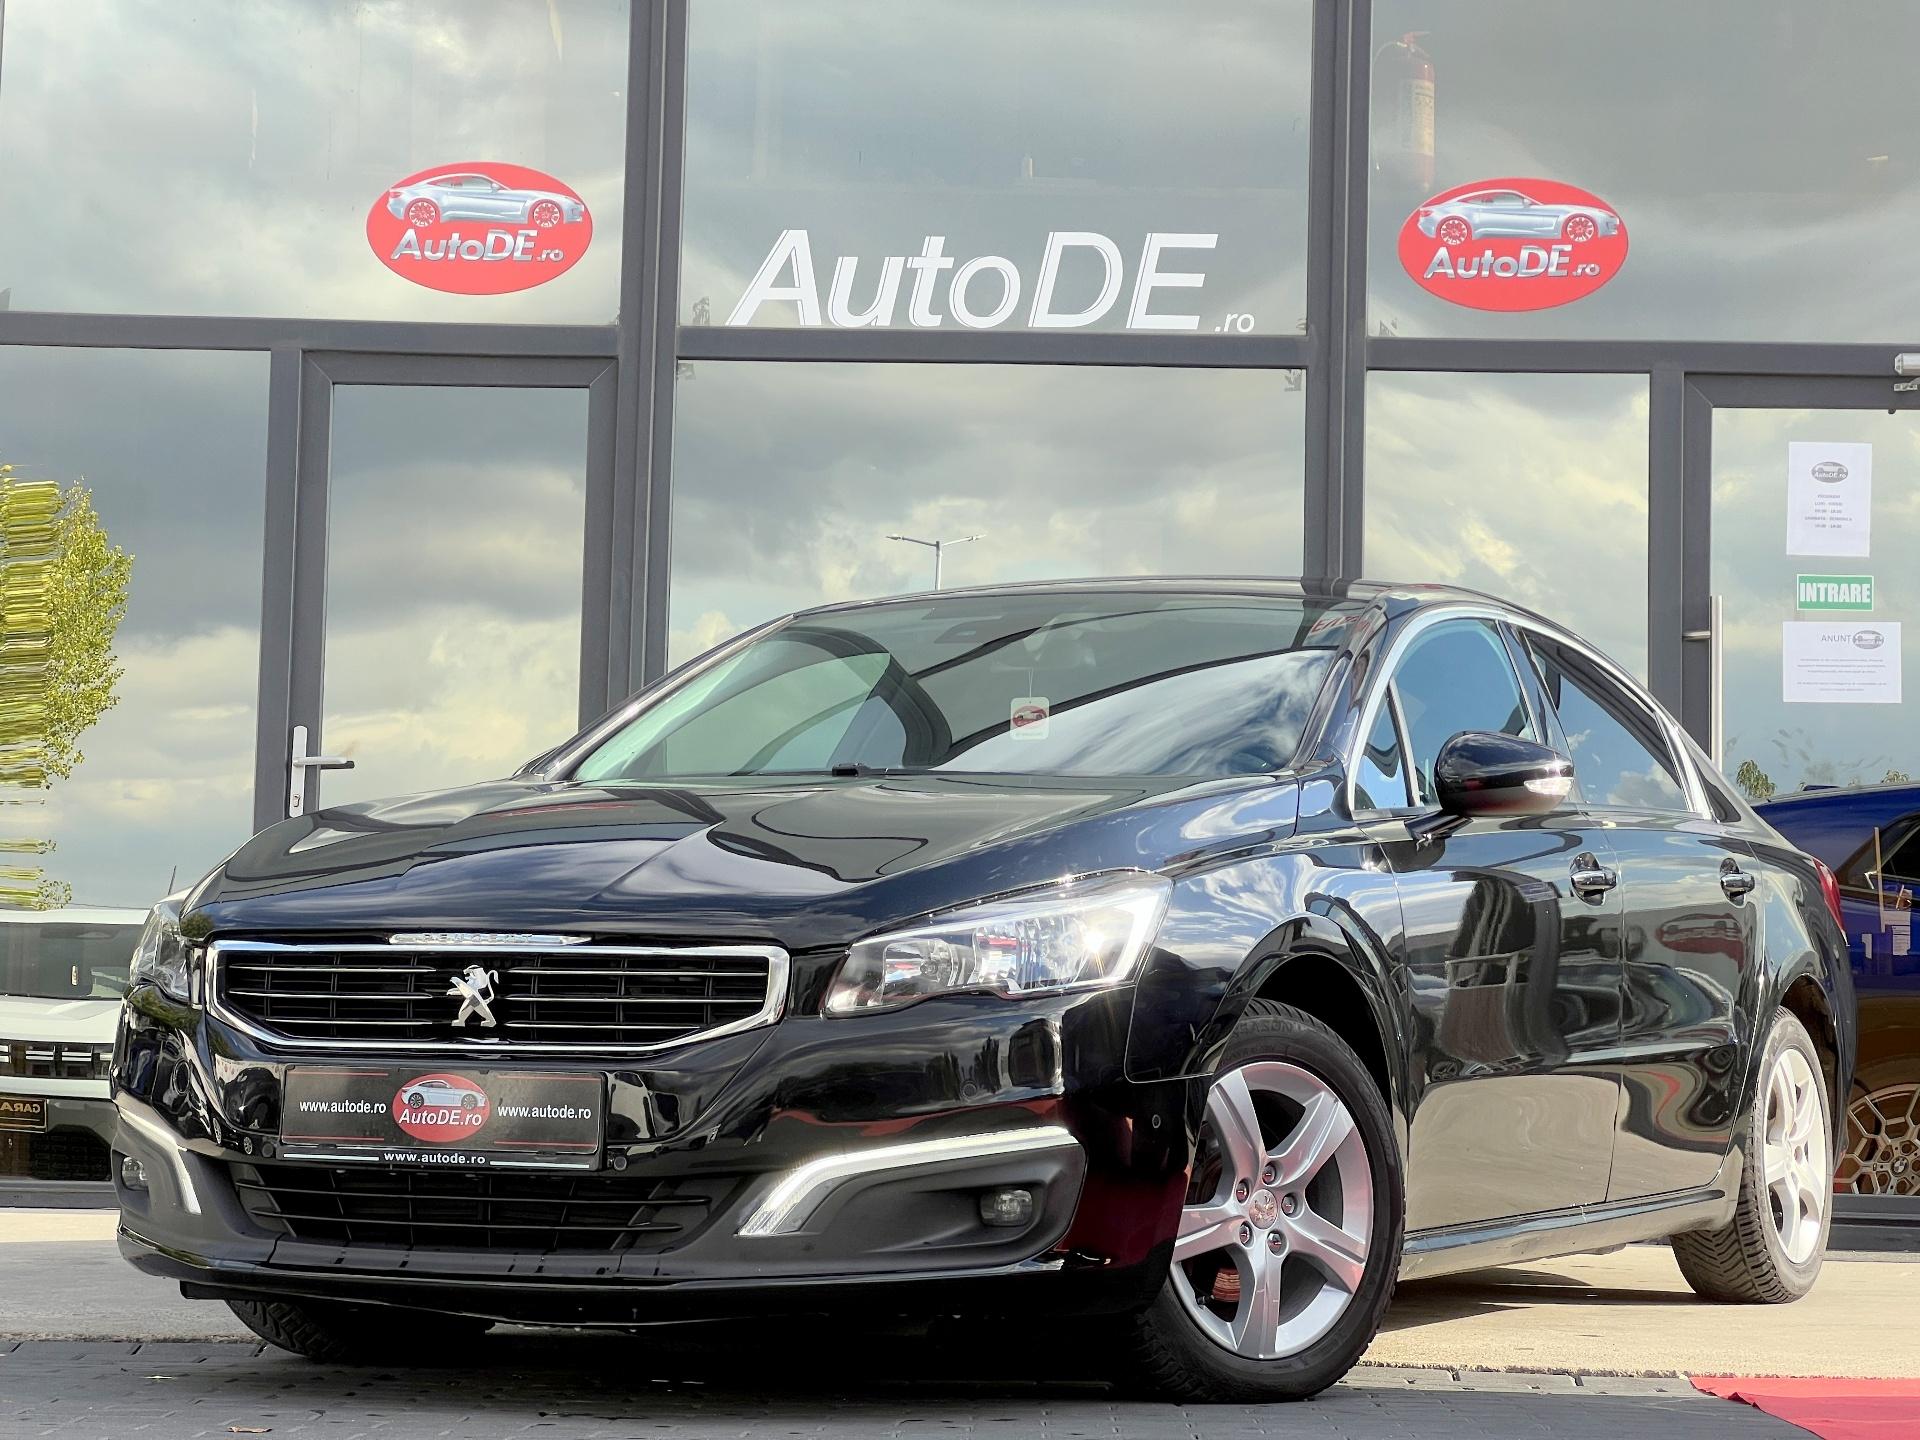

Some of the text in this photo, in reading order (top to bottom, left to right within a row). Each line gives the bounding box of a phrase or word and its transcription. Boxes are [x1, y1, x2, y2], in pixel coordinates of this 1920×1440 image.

[1799, 582, 1871, 603] INTRARE
[299, 1099, 387, 1114] www.autode.ro
[497, 1102, 591, 1119] www.autode.ro
[398, 1109, 483, 1126] AutoDE.ro
[384, 1151, 486, 1164] www.autode.ro
